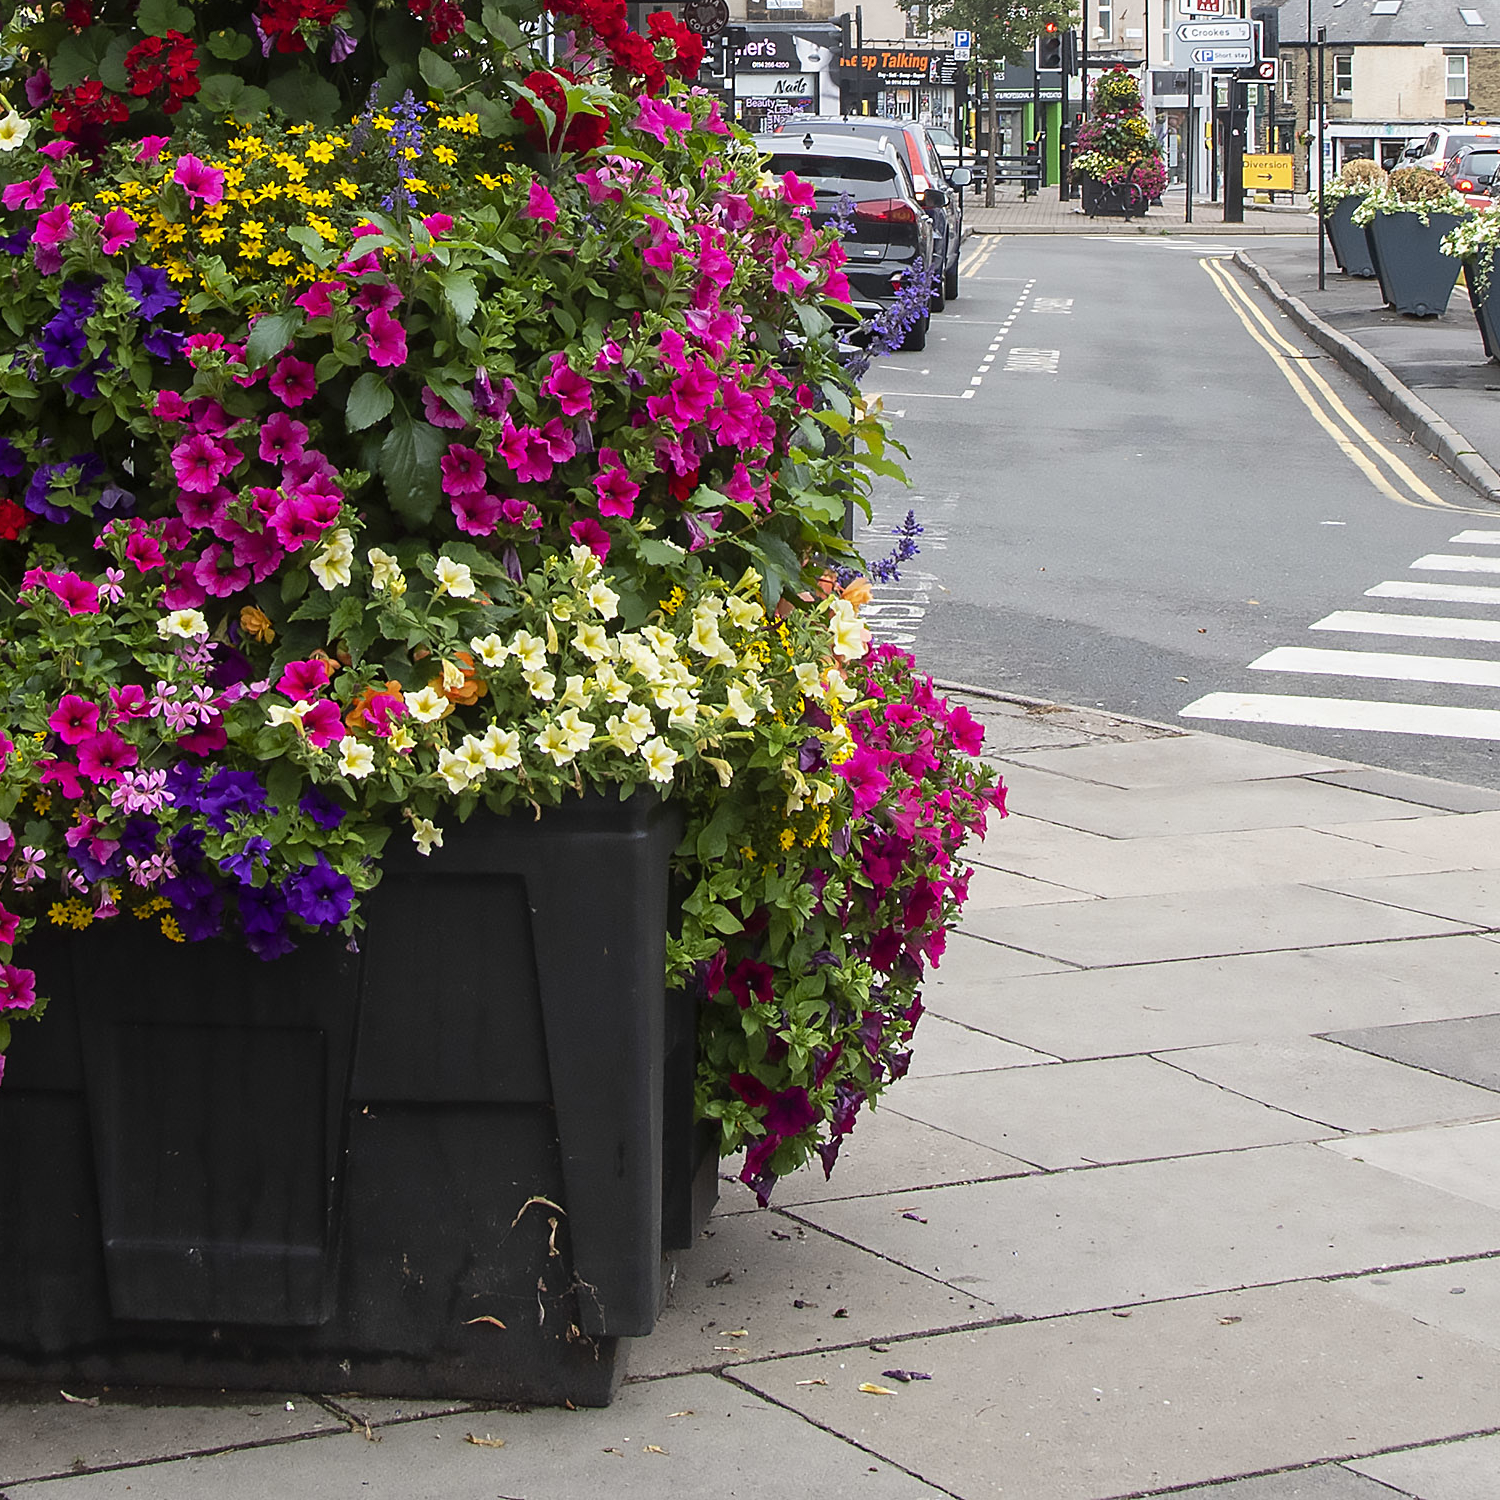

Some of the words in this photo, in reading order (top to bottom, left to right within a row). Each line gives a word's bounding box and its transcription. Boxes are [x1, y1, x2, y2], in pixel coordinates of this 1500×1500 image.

[1199, 3, 1217, 11] A&E
[690, 18, 723, 33] COFFEE
[1191, 28, 1230, 37] Crookes
[1234, 51, 1248, 59] stay
[881, 52, 929, 71] Talking
[773, 77, 808, 95] Nails
[746, 98, 776, 109] Beauty
[1242, 159, 1288, 170] Diversion
